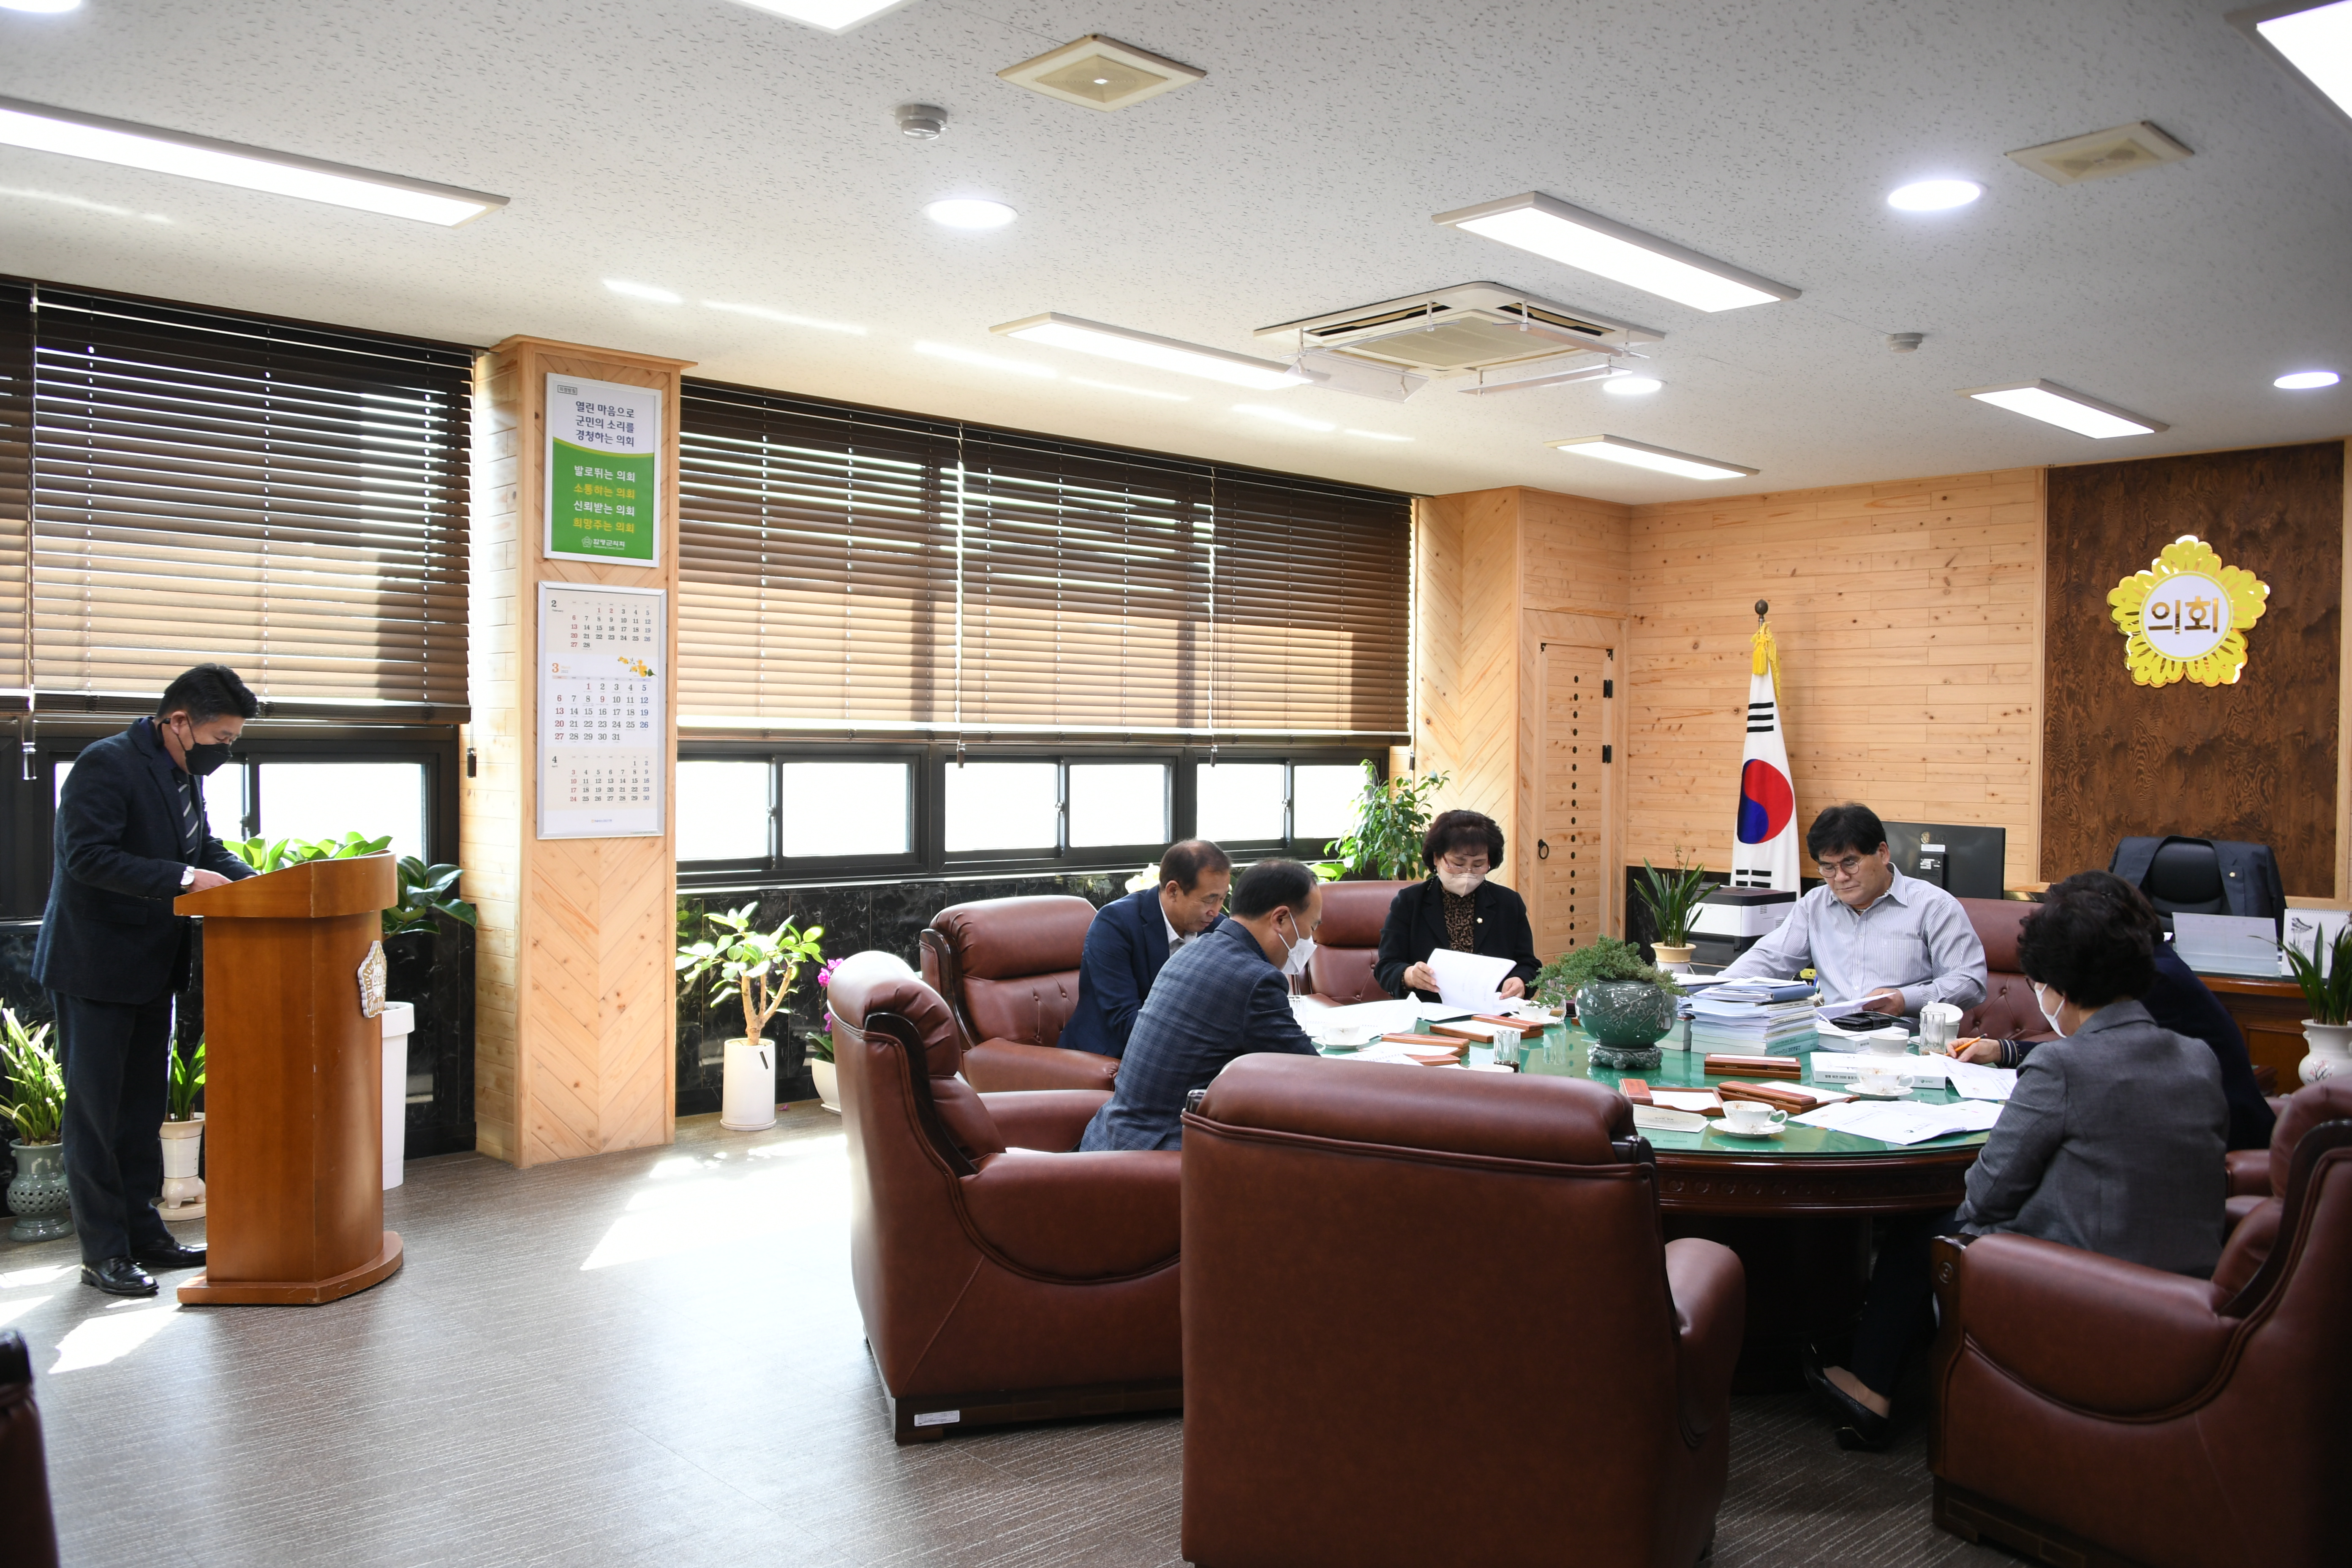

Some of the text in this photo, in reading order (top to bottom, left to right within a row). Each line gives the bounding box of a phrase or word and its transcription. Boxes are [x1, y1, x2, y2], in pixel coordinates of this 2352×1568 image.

[576, 401, 634, 418] 열린 마음으로
[576, 415, 634, 433] 군민의 소리를
[576, 430, 634, 447] 경청하는 의회
[574, 465, 635, 482] 발로뛰는 의회
[574, 484, 635, 499] 소통하는 의회
[574, 500, 634, 517] 신뢰받는 의회
[573, 517, 634, 533] 희망주는 의회
[593, 539, 625, 547] 함평군의회
[2148, 596, 2218, 634] 의회
[552, 663, 559, 673] 3
